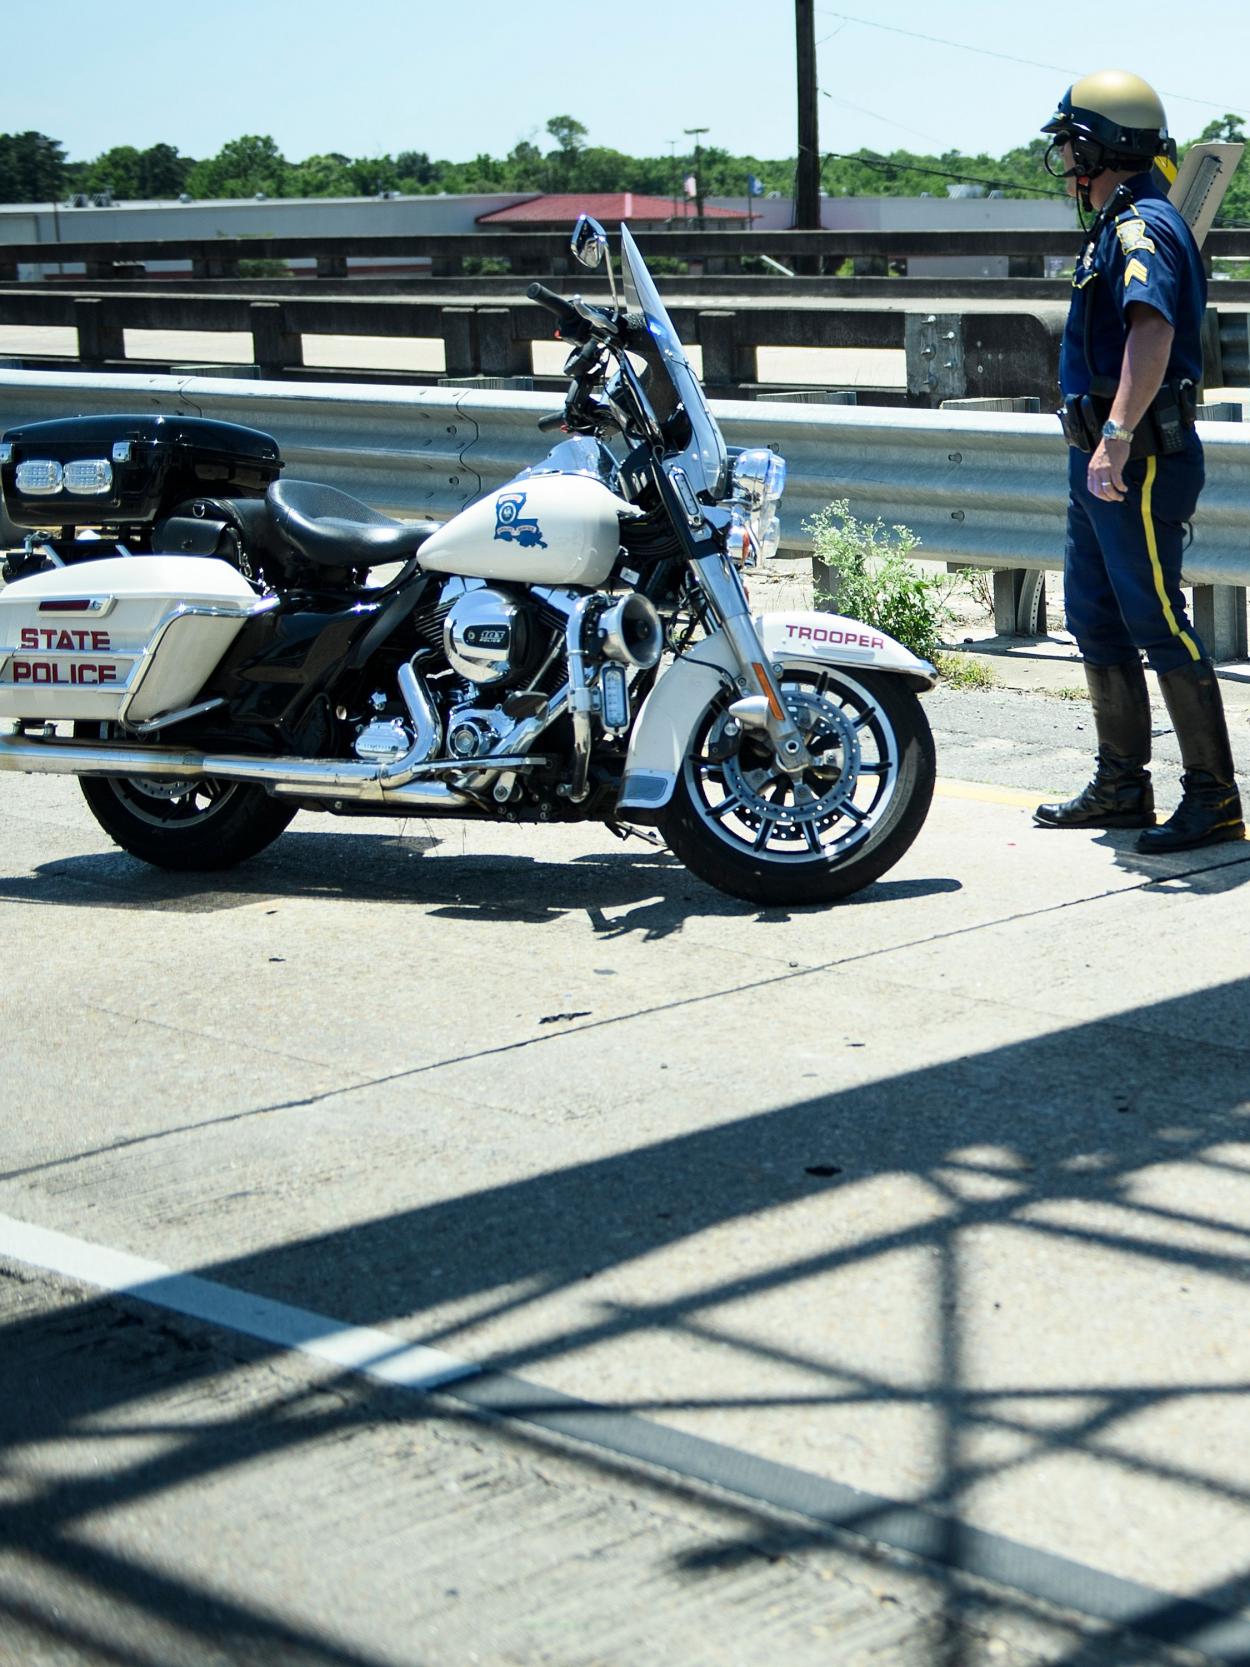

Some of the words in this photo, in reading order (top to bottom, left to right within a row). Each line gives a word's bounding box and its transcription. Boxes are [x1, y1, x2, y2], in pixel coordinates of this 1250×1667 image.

[21, 628, 111, 650] STATE
[786, 624, 884, 649] TROOPER
[13, 661, 117, 684] POLICE
